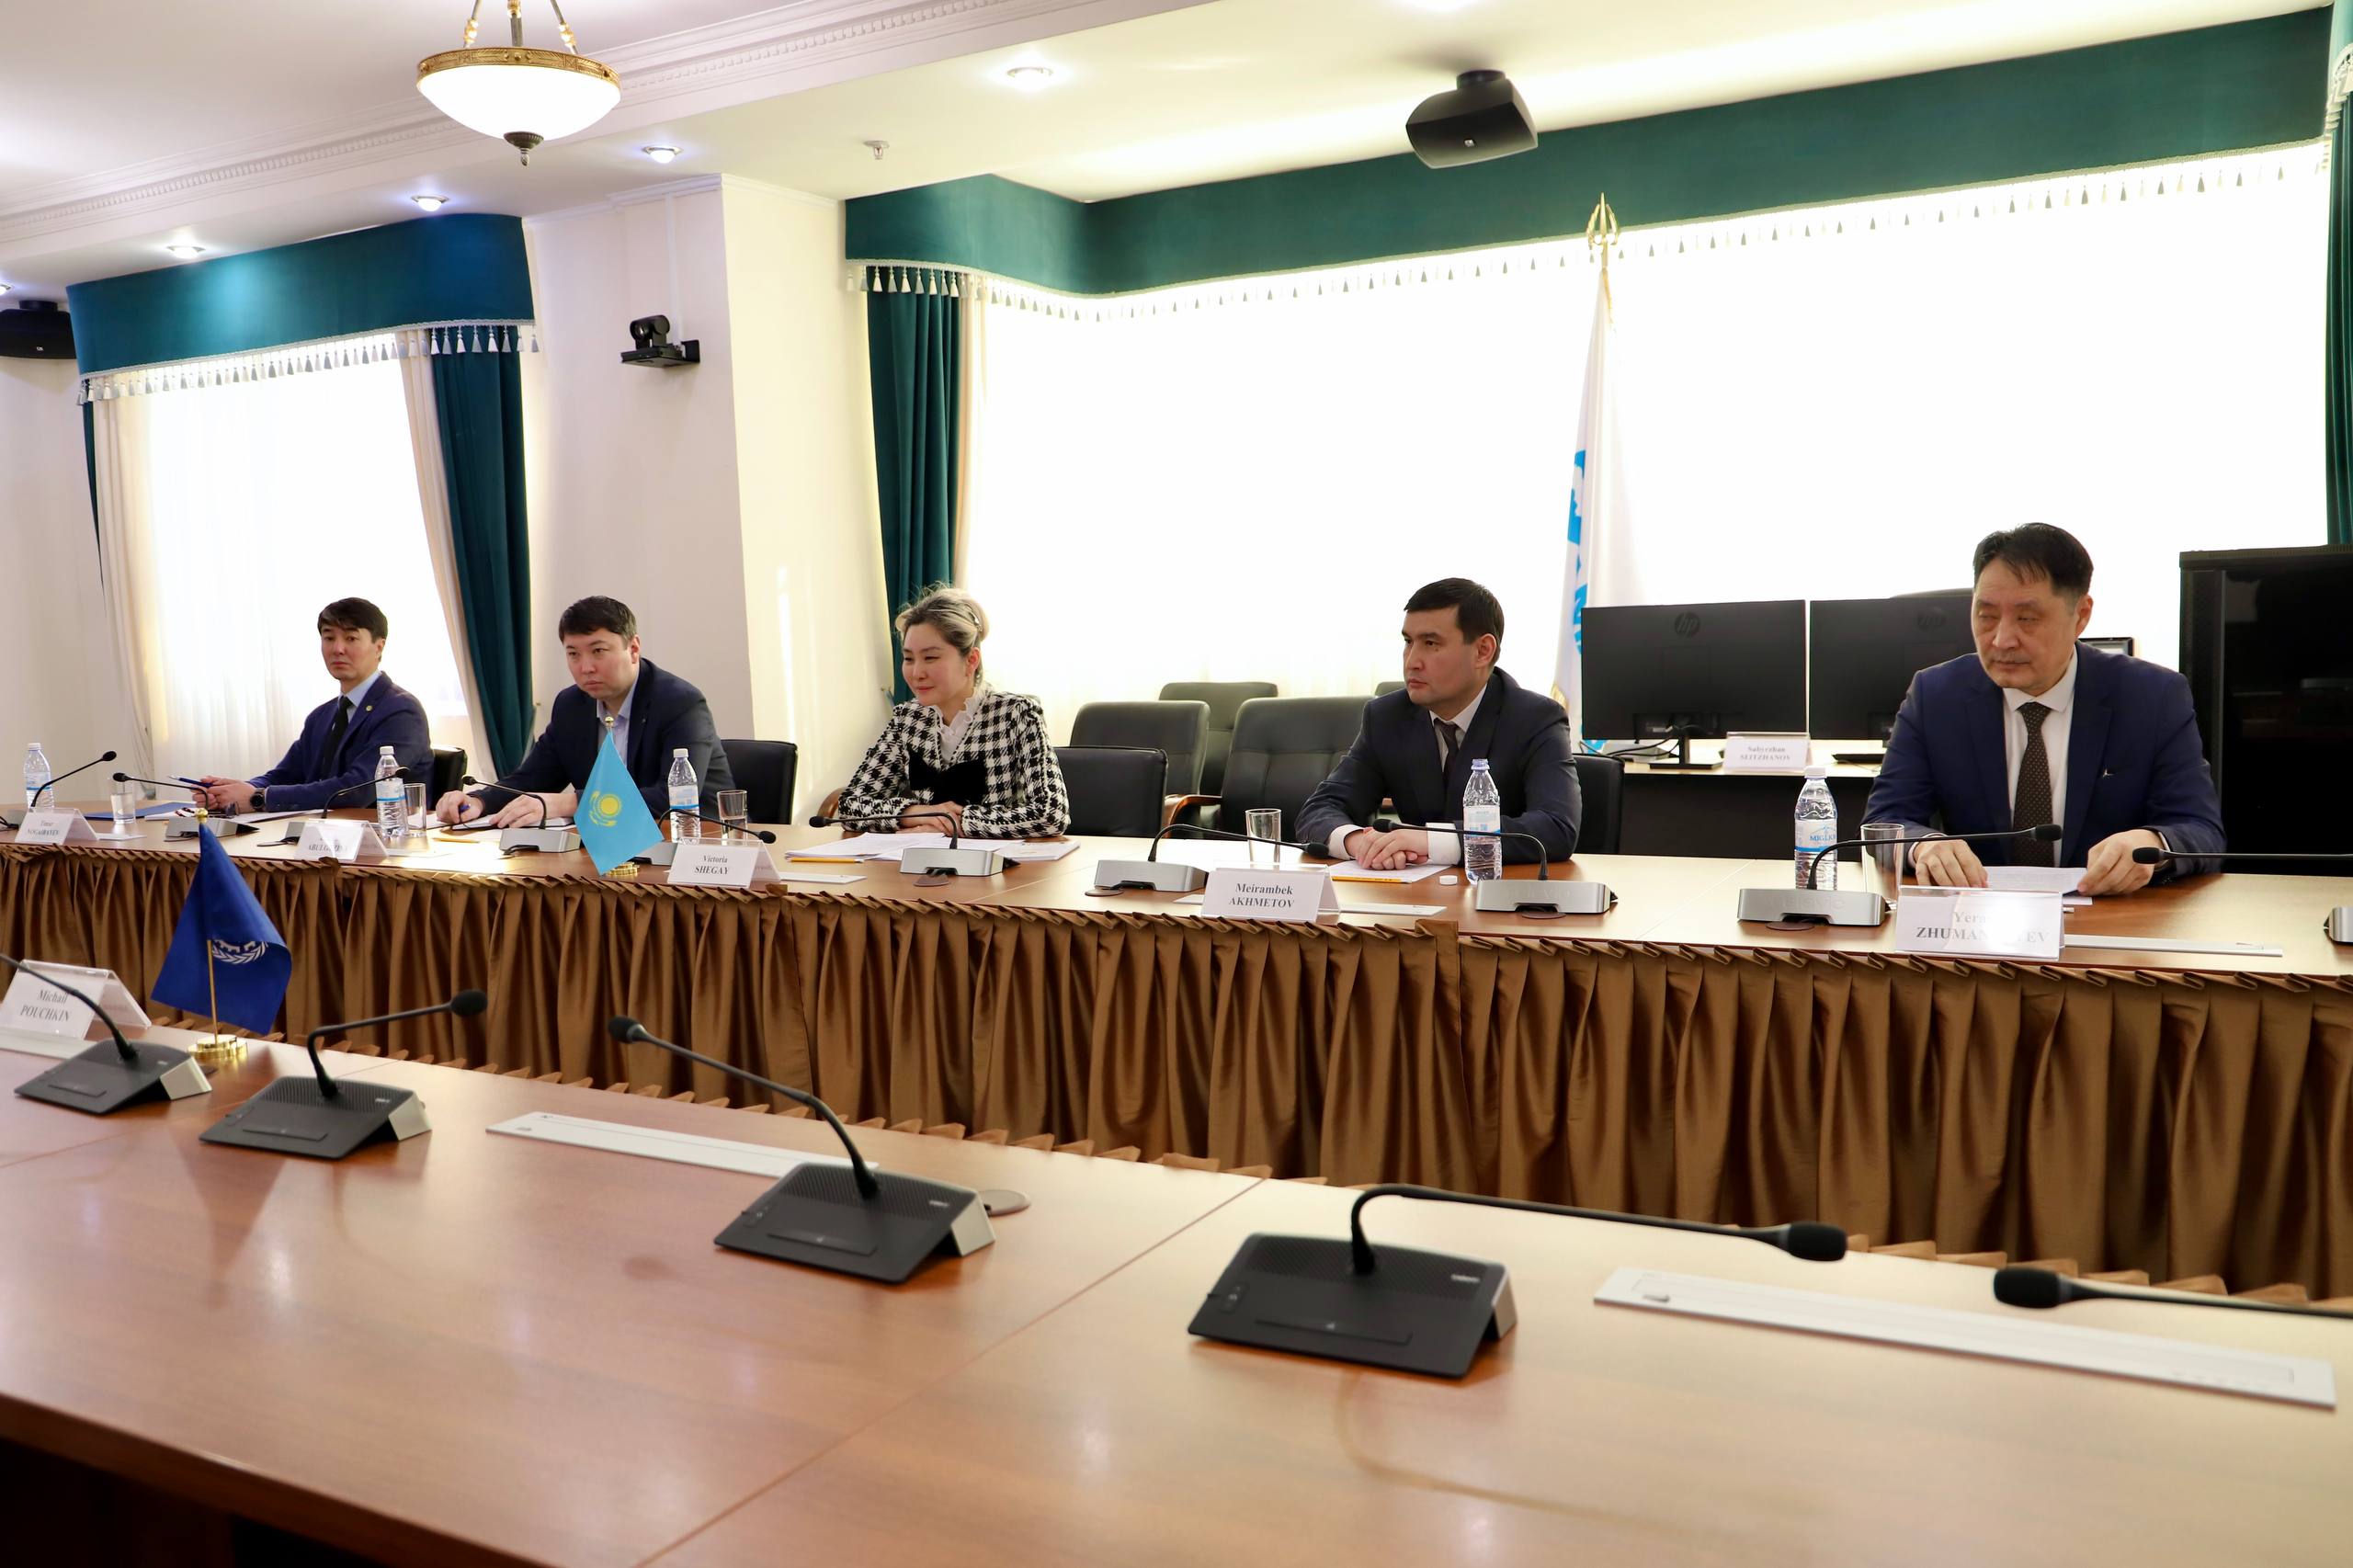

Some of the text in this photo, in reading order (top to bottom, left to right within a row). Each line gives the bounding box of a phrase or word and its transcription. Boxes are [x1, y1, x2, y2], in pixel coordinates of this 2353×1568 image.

[1676, 612, 1699, 638] hp
[703, 855, 728, 864] Victoria
[695, 866, 729, 875] SHEGAY
[1235, 883, 1293, 895] Meirambek
[1229, 896, 1295, 908] AKHMETOV
[20, 1005, 69, 1021] POUCHKIN
